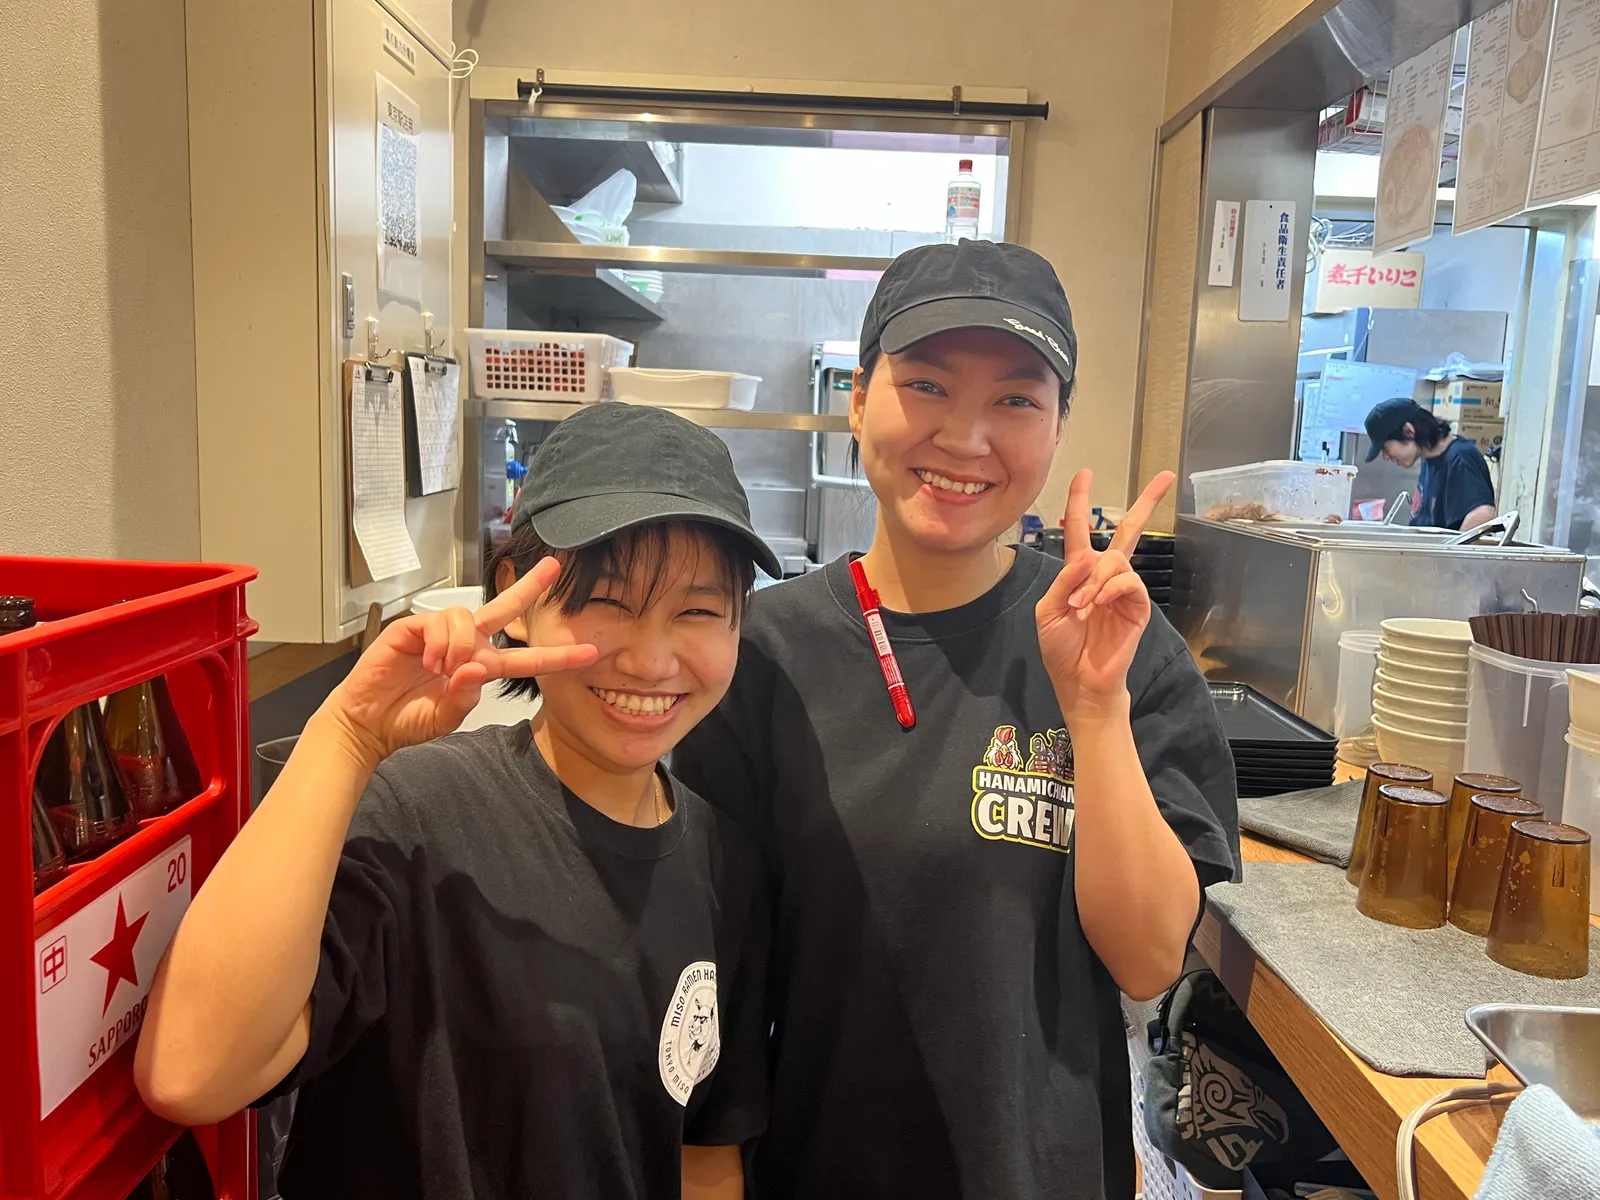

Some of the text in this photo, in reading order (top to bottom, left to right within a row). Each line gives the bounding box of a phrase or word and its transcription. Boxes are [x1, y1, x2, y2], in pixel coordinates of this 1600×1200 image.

[1276, 212, 1289, 290] 食品衛生責任者
[978, 792, 1075, 847] CREW
[167, 852, 187, 893] 20
[44, 946, 64, 983] 中
[671, 996, 685, 1028] MISO
[682, 970, 702, 996] RAMEN
[665, 1041, 689, 1094] TOKYO MISO
